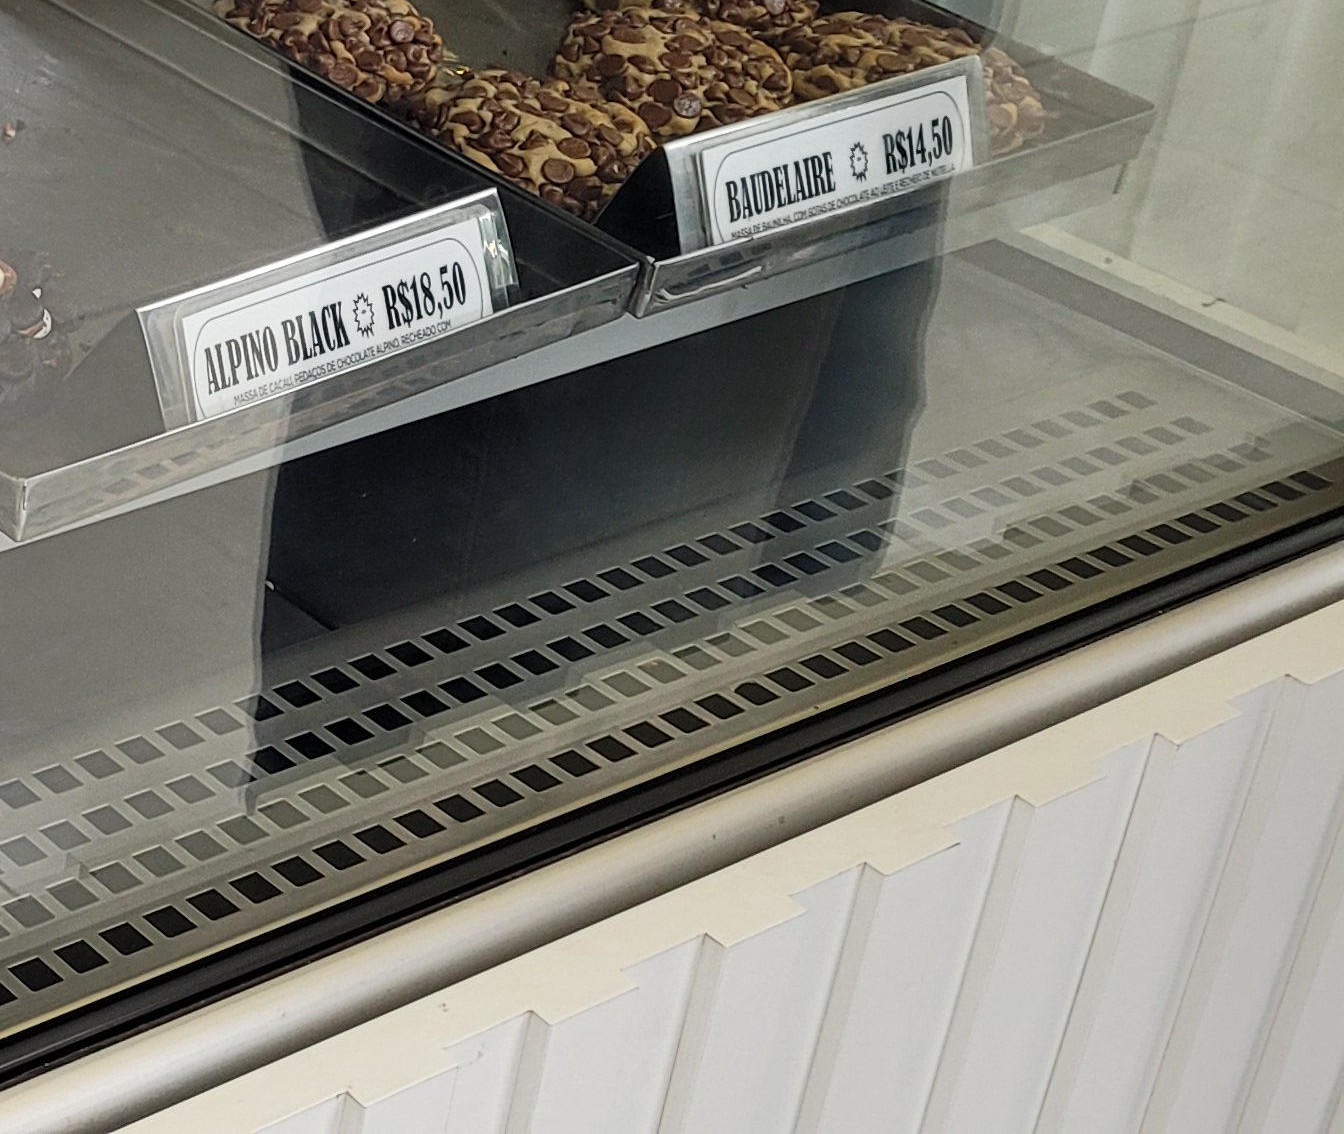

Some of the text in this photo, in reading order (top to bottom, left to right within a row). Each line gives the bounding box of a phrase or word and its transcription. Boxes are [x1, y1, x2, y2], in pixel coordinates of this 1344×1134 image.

[725, 116, 952, 223] BAUDELAIRE R$14,50
[204, 260, 465, 393] ALPINO BLACK R$18,50
[233, 388, 258, 405] MASSA
[258, 384, 267, 396] DE
[294, 363, 325, 385] PEDAÇOS
[326, 359, 336, 372] DE
[337, 346, 374, 368] CHOCOLATE
[401, 324, 435, 345] RECHEADO
[436, 319, 451, 332] COM
